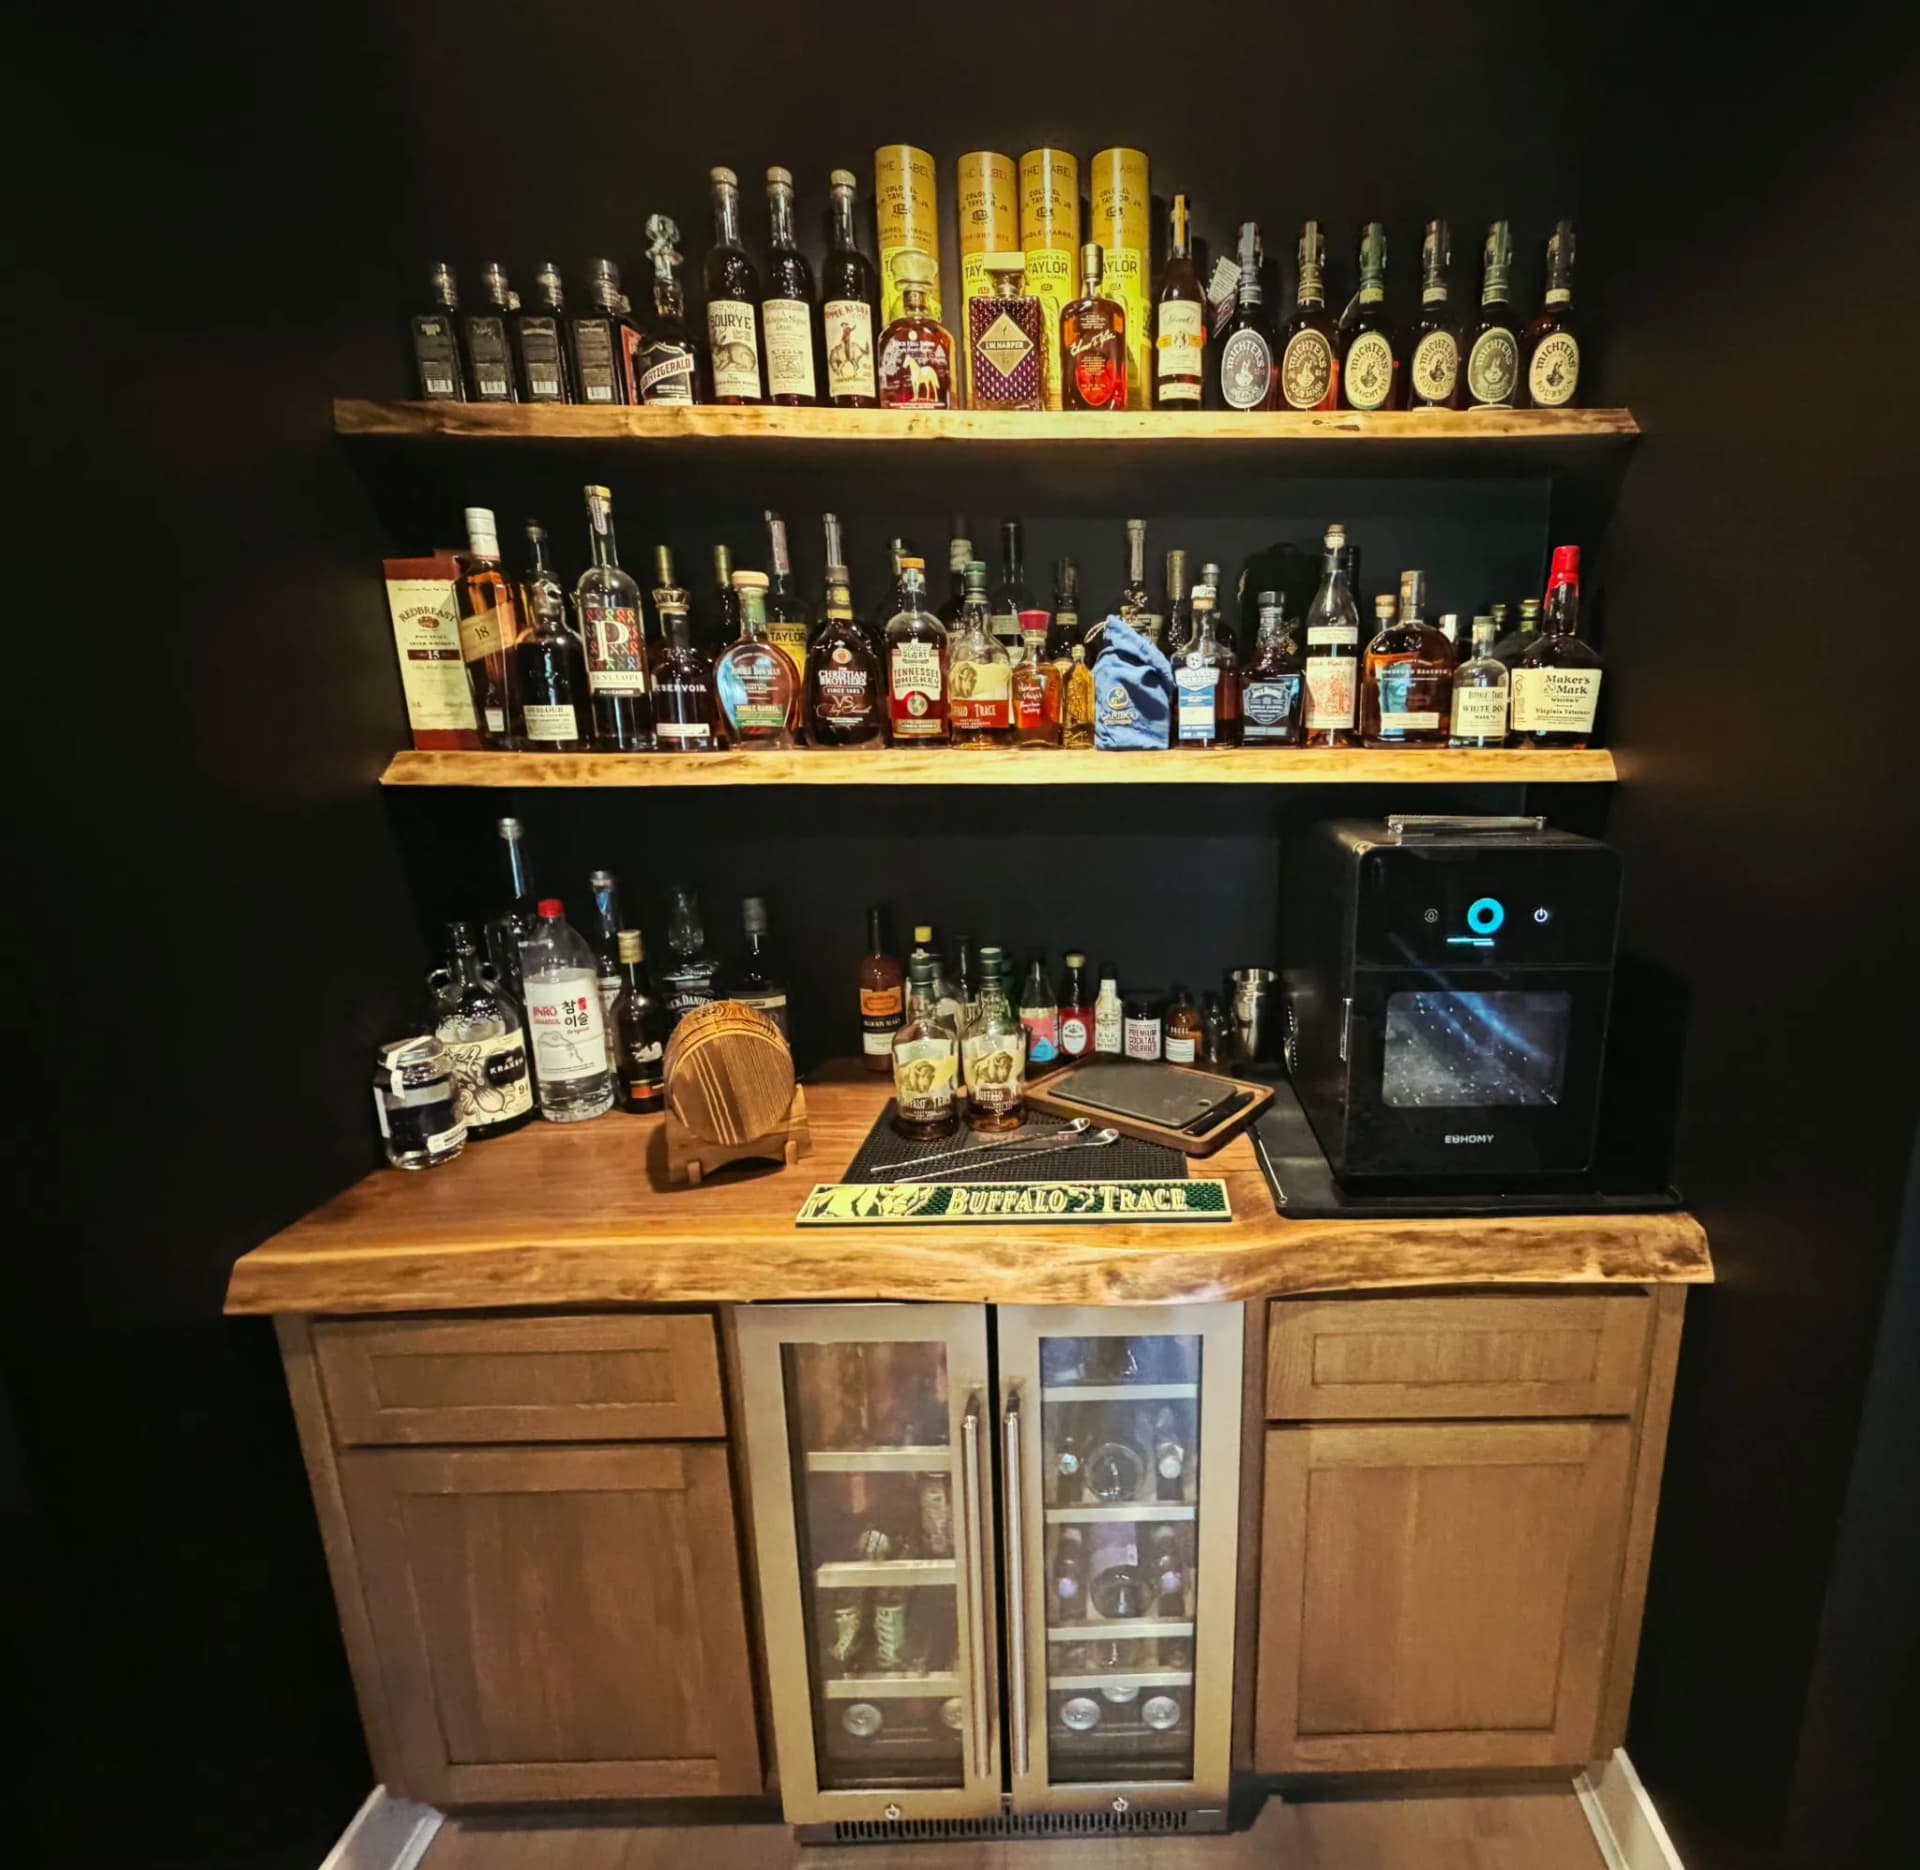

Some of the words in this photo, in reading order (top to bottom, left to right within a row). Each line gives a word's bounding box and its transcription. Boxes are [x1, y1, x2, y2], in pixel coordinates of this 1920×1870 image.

[709, 313, 752, 330] BOURYE
[399, 605, 456, 622] REDBREAST
[474, 625, 490, 641] 18
[894, 667, 939, 678] TENNESSEE
[1544, 674, 1590, 685] Maker's
[656, 684, 707, 693] ESERVOIR
[1556, 685, 1588, 695] Mark
[490, 1057, 524, 1074] KRAKEN
[1444, 1134, 1494, 1144] EUHOMY
[946, 1187, 1068, 1214] BUFFALO
[1099, 1185, 1187, 1213] TRACE
